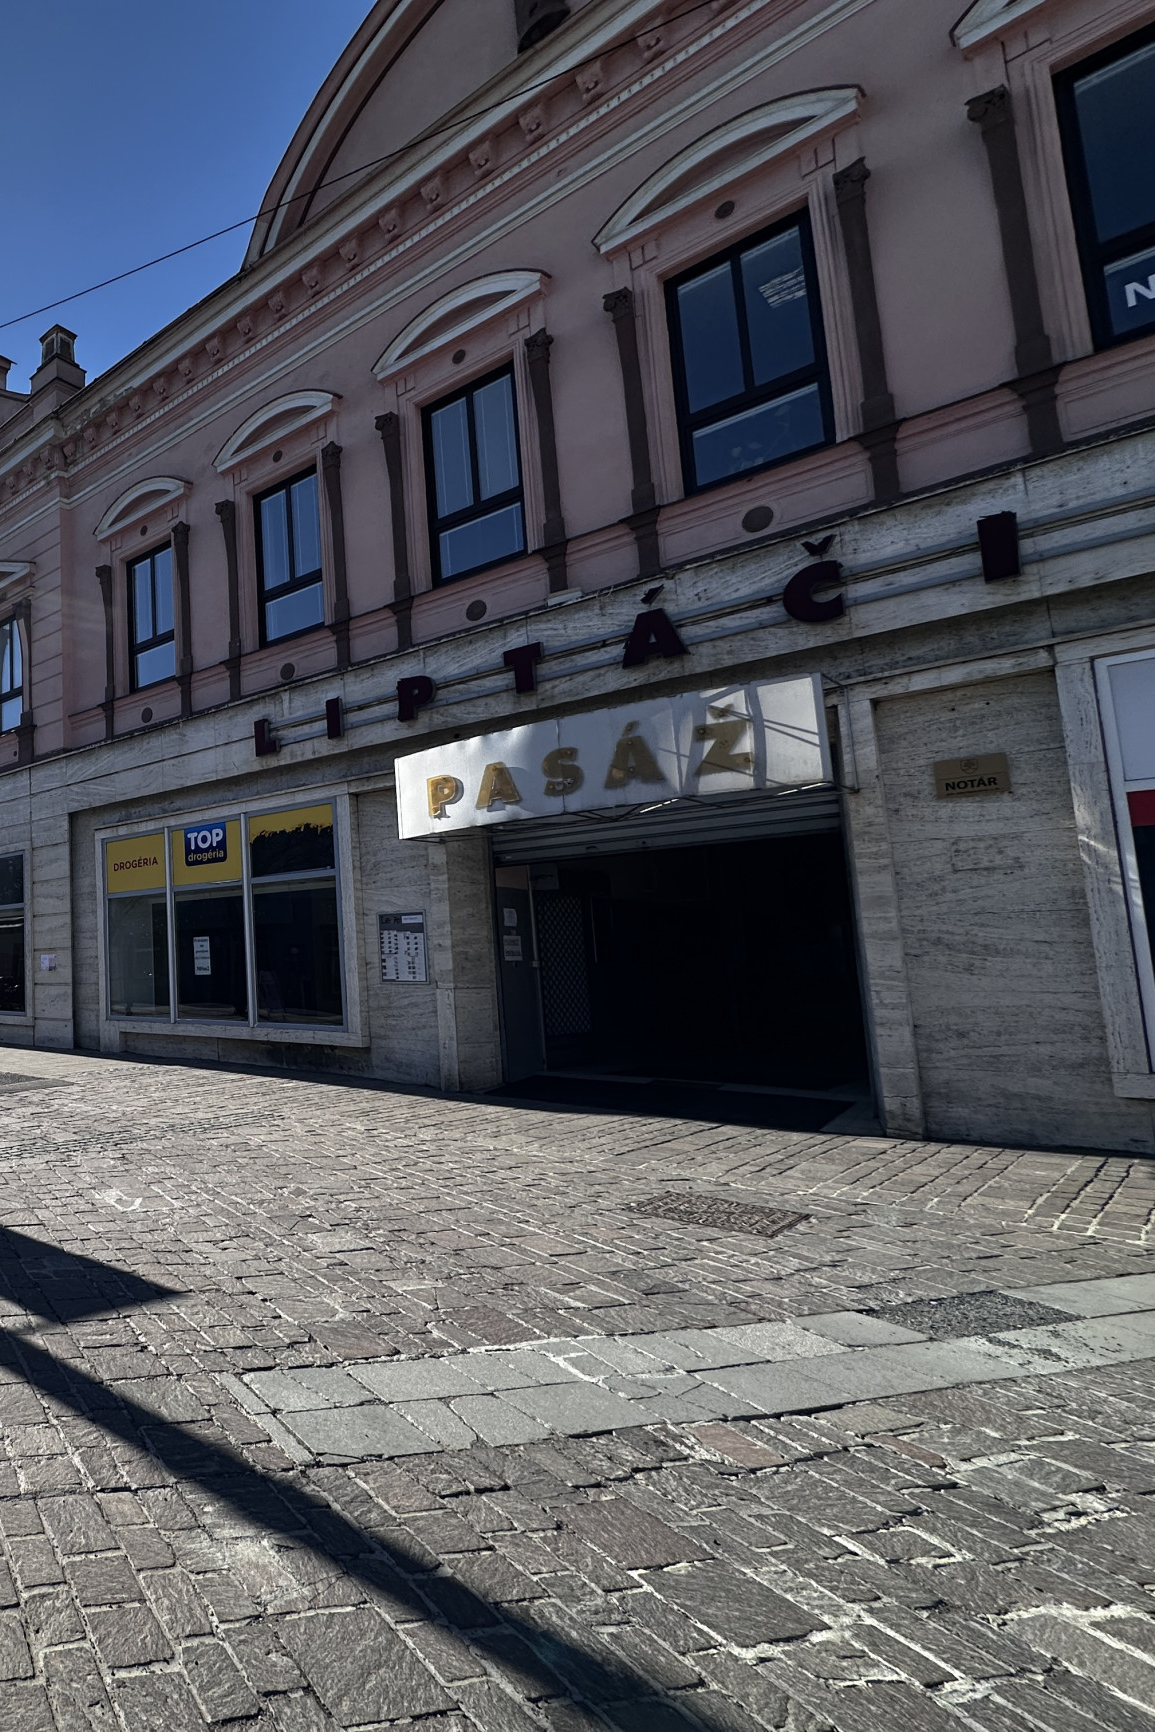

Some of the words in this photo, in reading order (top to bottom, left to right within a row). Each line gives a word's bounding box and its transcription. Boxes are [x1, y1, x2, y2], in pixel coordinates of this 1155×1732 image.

[427, 700, 756, 820] PASÁŽ
[945, 776, 998, 791] NOTÁR
[187, 828, 224, 850] TOP
[113, 856, 159, 872] DROGÉRIA
[187, 849, 225, 863] drogéria
